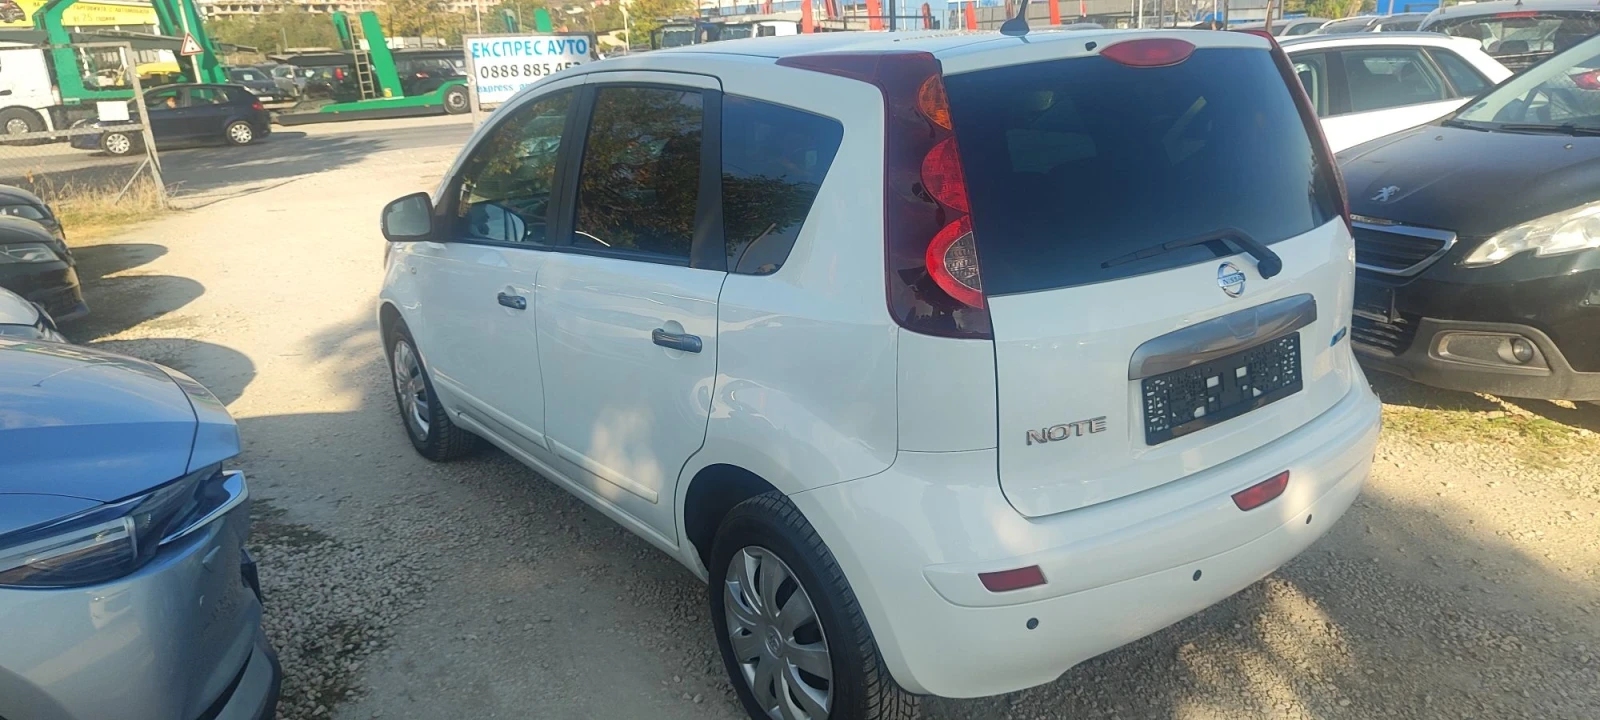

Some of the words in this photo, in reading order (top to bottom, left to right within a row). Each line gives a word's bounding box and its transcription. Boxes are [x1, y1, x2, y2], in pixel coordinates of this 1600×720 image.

[472, 40, 542, 58] ЕКСПРЕС
[548, 39, 587, 55] АУТО
[480, 64, 519, 79] 0888
[523, 63, 550, 77] 885
[1026, 415, 1107, 446] NOTE
